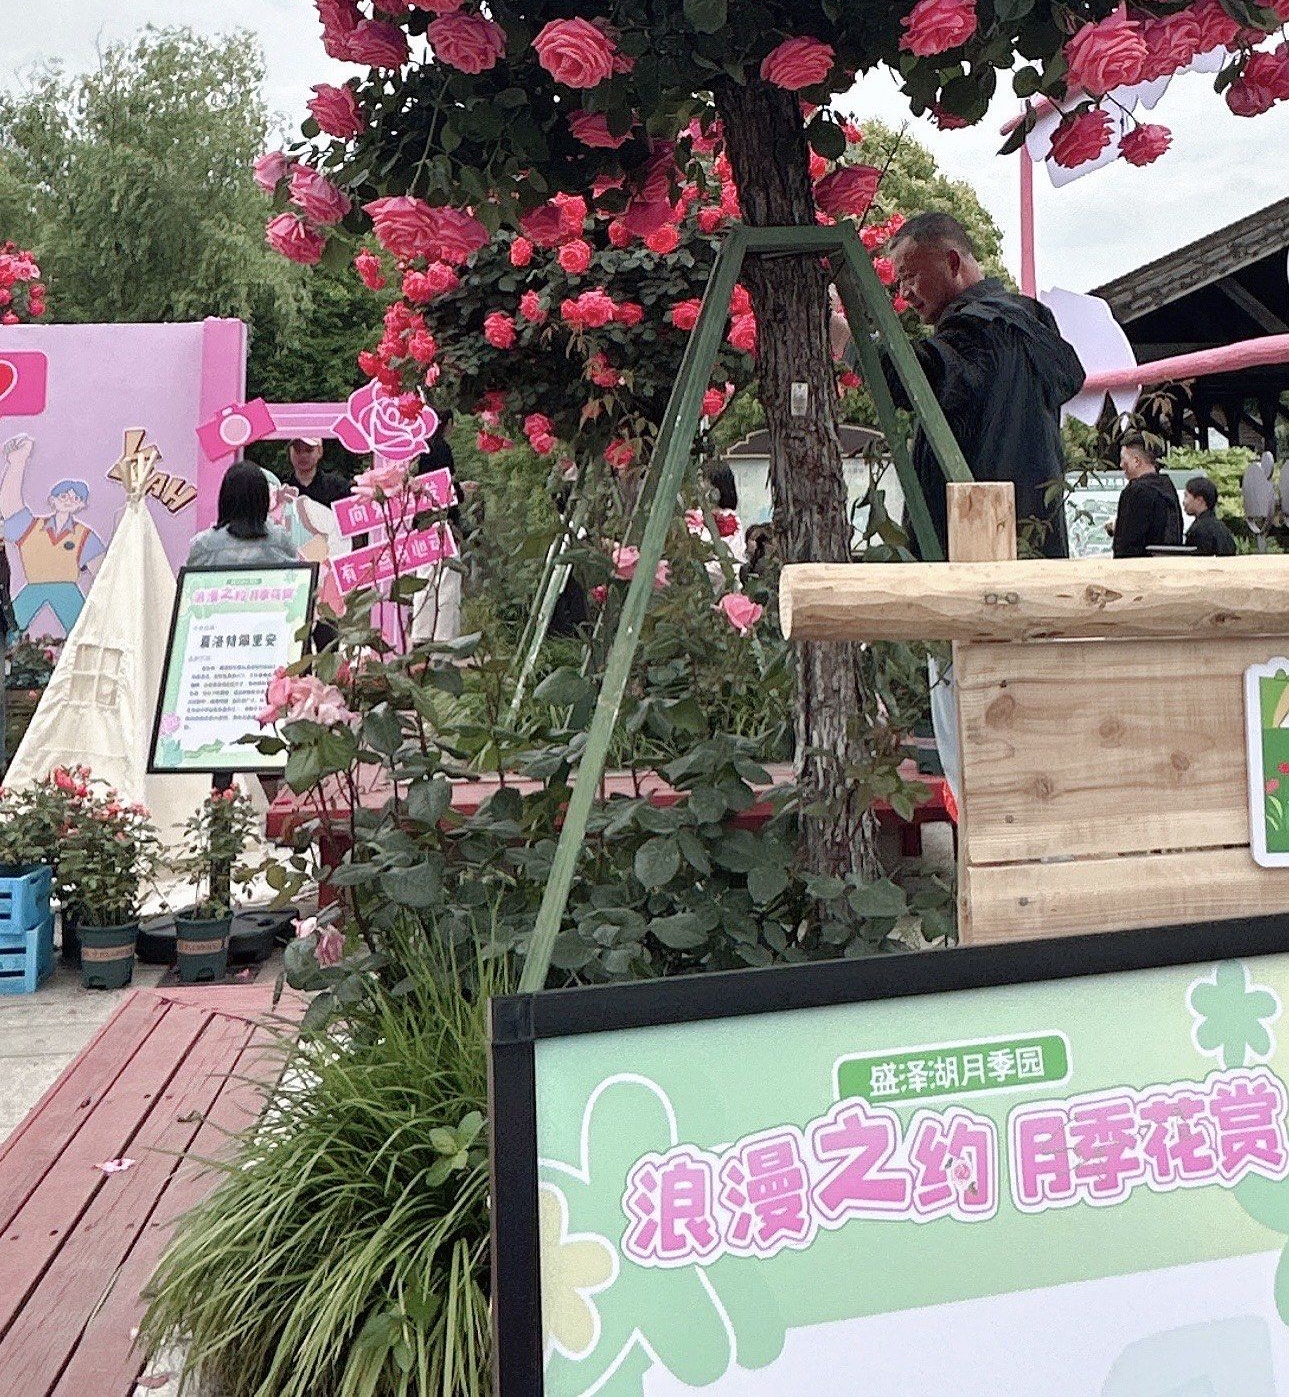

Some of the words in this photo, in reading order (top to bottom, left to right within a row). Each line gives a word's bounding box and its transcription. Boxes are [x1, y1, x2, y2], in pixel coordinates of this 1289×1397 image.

[869, 1044, 1045, 1097] 盛泽湖月季园
[630, 1110, 991, 1253] 浪漫之约
[1017, 1081, 1285, 1200] 月季花赏
